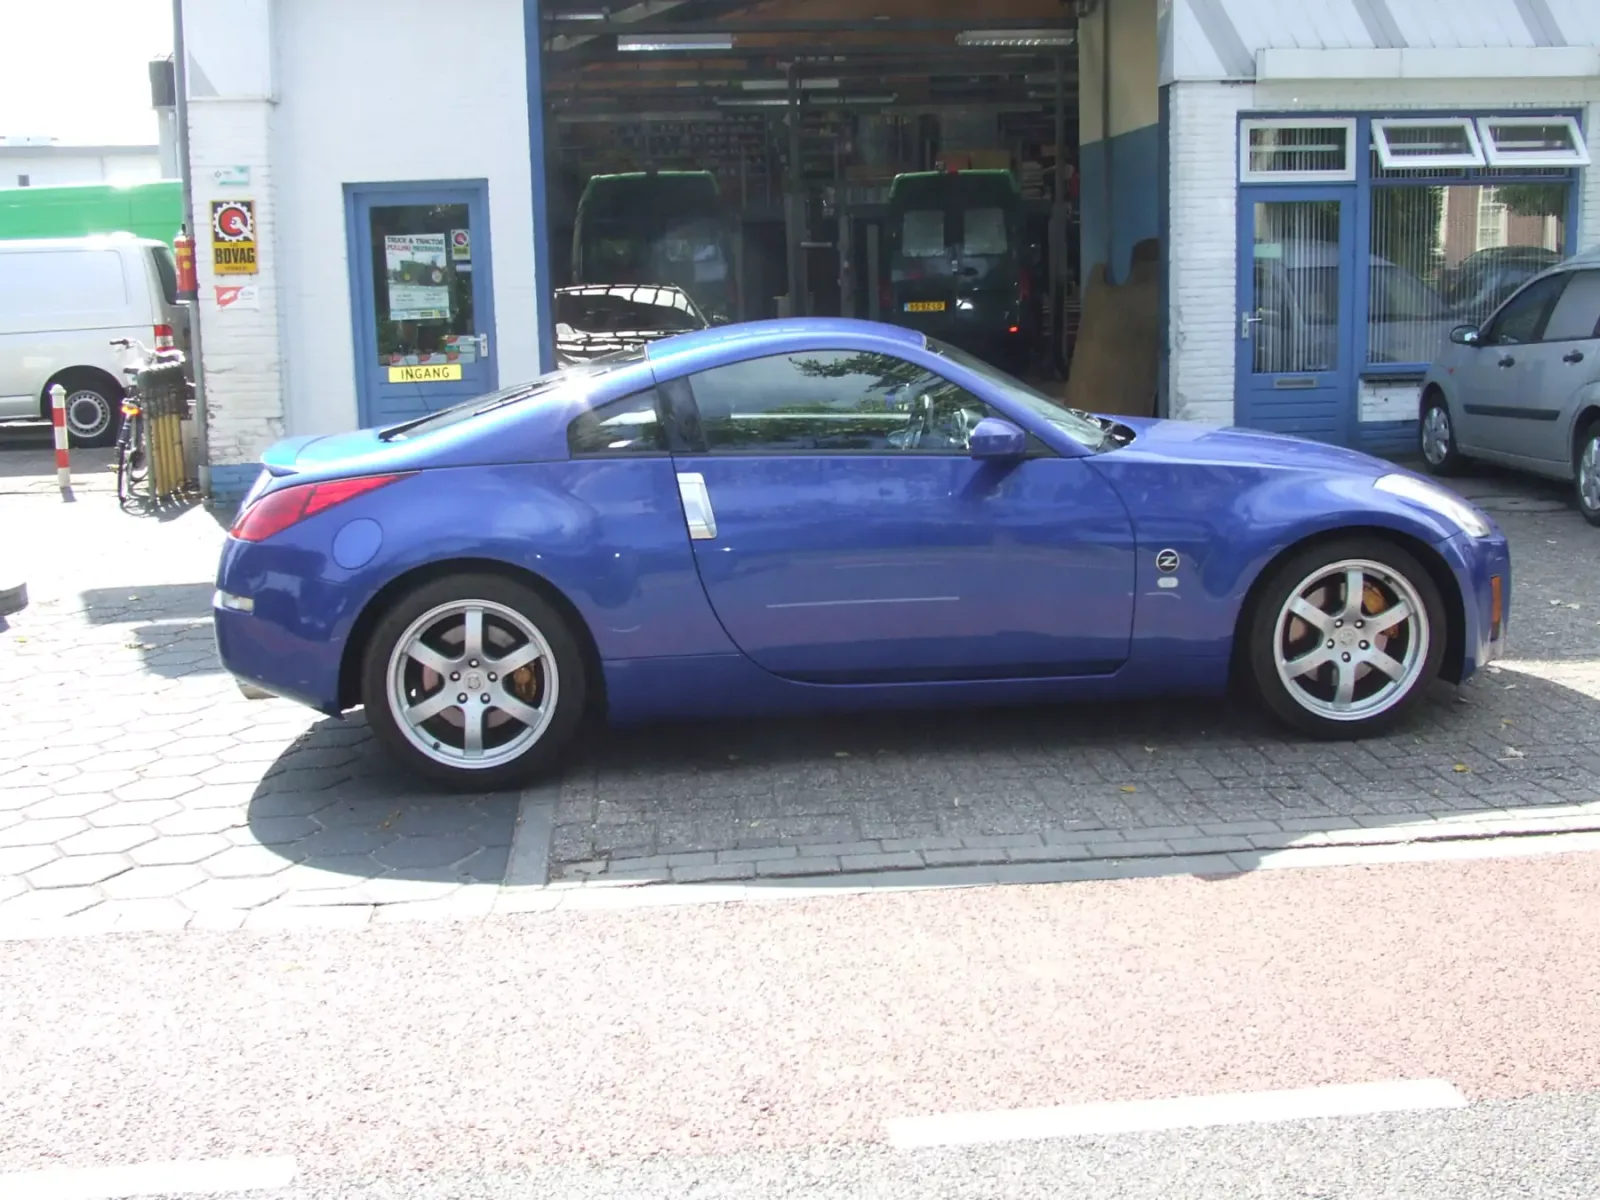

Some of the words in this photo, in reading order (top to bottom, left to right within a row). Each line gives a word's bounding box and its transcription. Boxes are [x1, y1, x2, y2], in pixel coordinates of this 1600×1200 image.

[387, 236, 407, 244] TRUCK
[215, 247, 255, 264] BOVAG
[400, 366, 450, 380] INGANG
